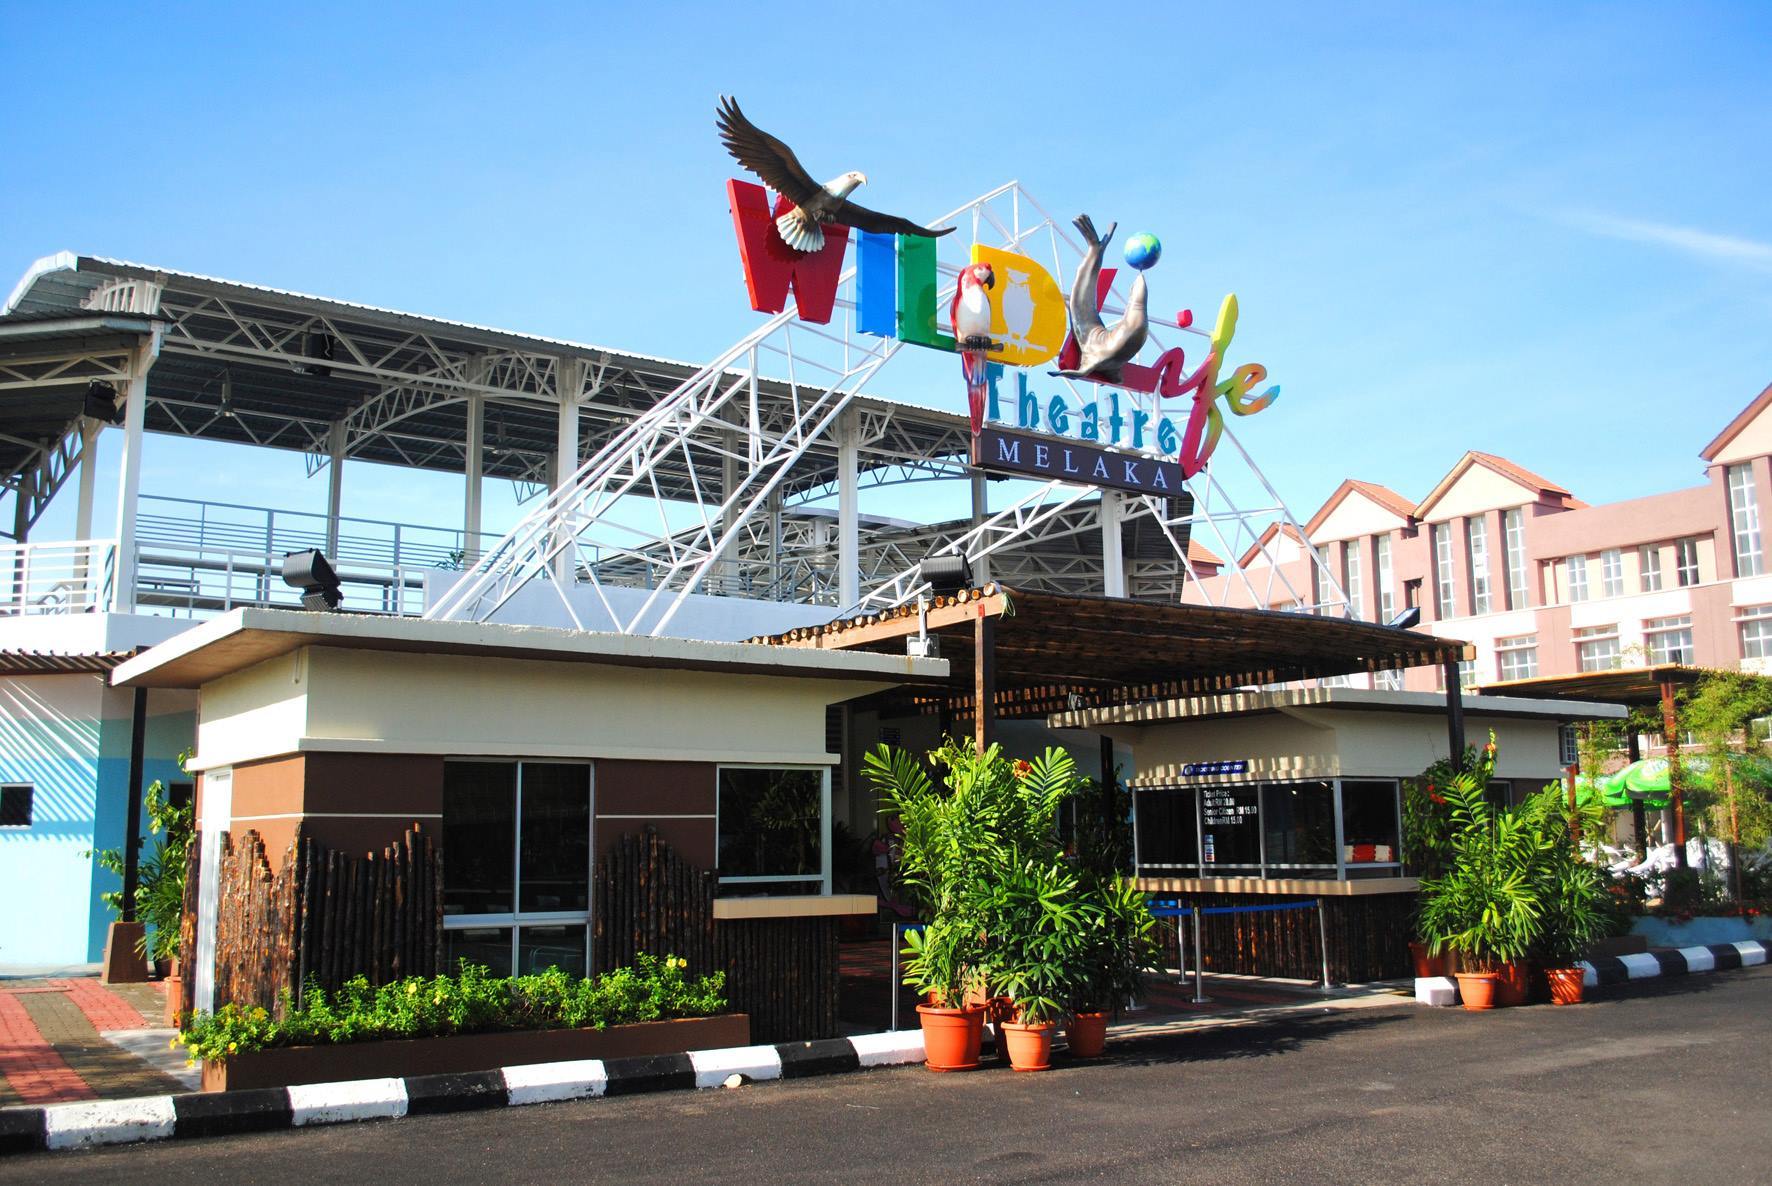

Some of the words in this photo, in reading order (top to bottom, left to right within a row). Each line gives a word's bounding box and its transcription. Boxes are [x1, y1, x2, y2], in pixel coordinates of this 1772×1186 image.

[727, 178, 1066, 367] WILD
[984, 361, 1177, 455] Theatre
[997, 438, 1168, 489] MELAKA
